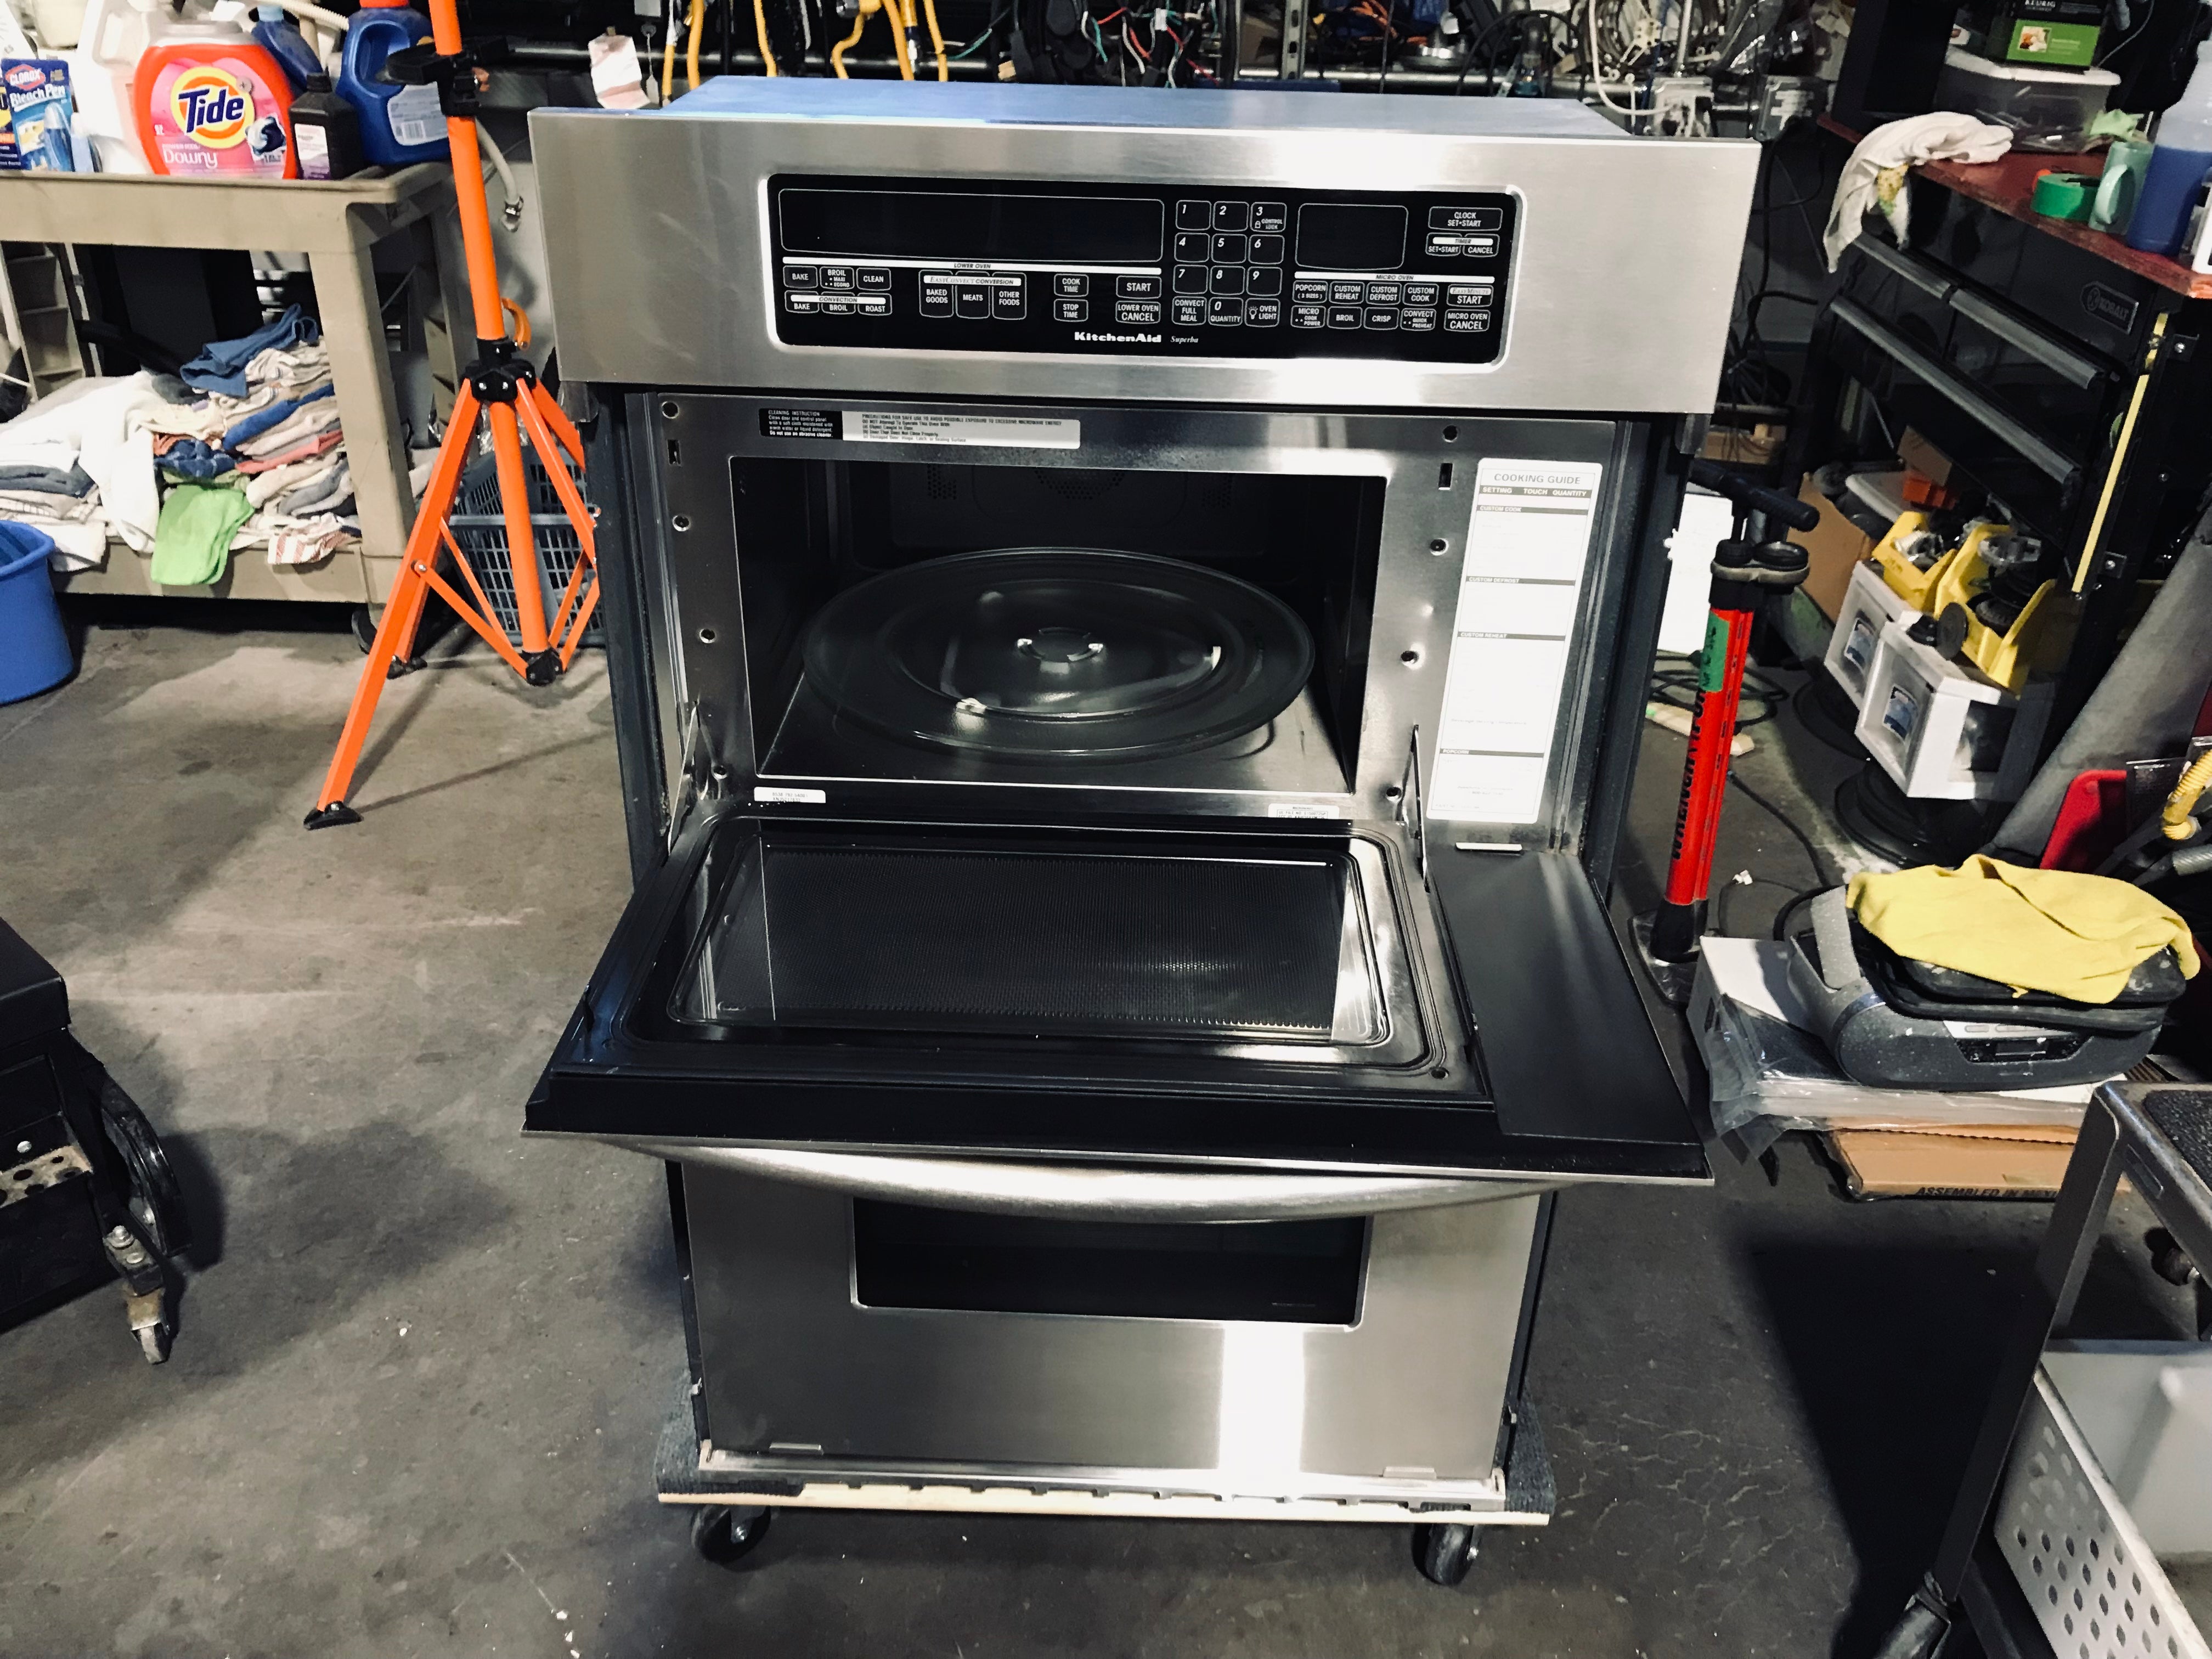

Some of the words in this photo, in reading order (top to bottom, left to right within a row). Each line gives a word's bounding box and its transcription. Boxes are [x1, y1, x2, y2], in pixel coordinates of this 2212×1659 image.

[10, 69, 41, 86] CLOROX
[10, 88, 45, 108] Bleach
[45, 83, 65, 98] Pen
[178, 88, 244, 133] Tide
[164, 148, 218, 170] Downy
[1183, 205, 1186, 213] 1
[1220, 206, 1226, 215] 2
[1256, 207, 1262, 216] 3
[1179, 237, 1186, 246] 4
[1218, 238, 1224, 247] 5
[1255, 239, 1261, 248] 6
[1178, 269, 1185, 278] 7
[1216, 270, 1222, 279] 8
[1252, 271, 1260, 280] 9
[1126, 283, 1151, 292] START
[1457, 296, 1482, 304] START
[1215, 302, 1221, 311] 0
[1121, 313, 1154, 321] CANCEL
[1450, 321, 1482, 329] CANCEL
[1074, 331, 1161, 342] KitchenAid
[1170, 336, 1198, 344] Superba
[1494, 473, 1544, 483] COOKING
[1548, 476, 1581, 484] GUIDE
[1916, 1187, 2000, 1197] ASSEMBLED
